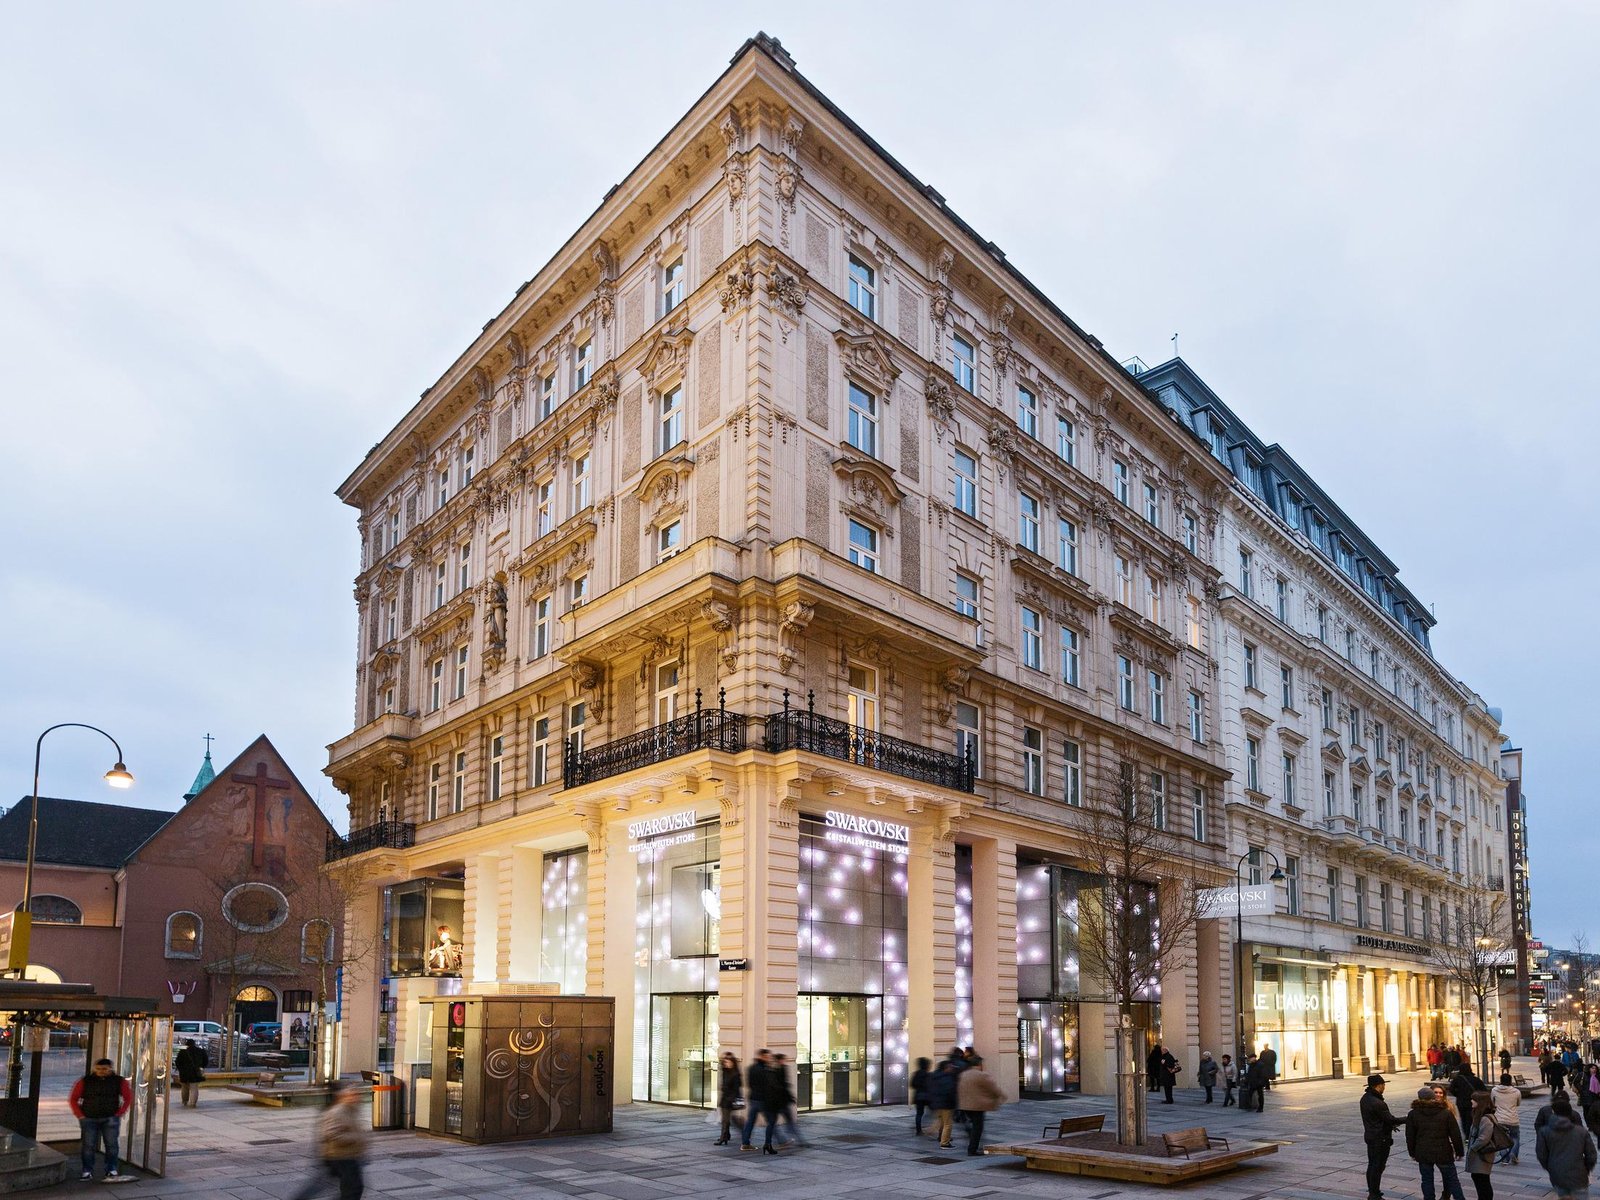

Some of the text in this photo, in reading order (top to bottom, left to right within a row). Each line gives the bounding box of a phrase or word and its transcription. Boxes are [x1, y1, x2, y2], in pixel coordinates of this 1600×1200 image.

[628, 810, 696, 839] SWAROVSKI
[825, 810, 909, 842] SWAROVSKI
[676, 832, 696, 844] STORE
[826, 832, 910, 855] KRISTALLWELTEN STORE
[1512, 812, 1524, 930] HOTEL EUROPA
[1359, 935, 1387, 950] HOTEL
